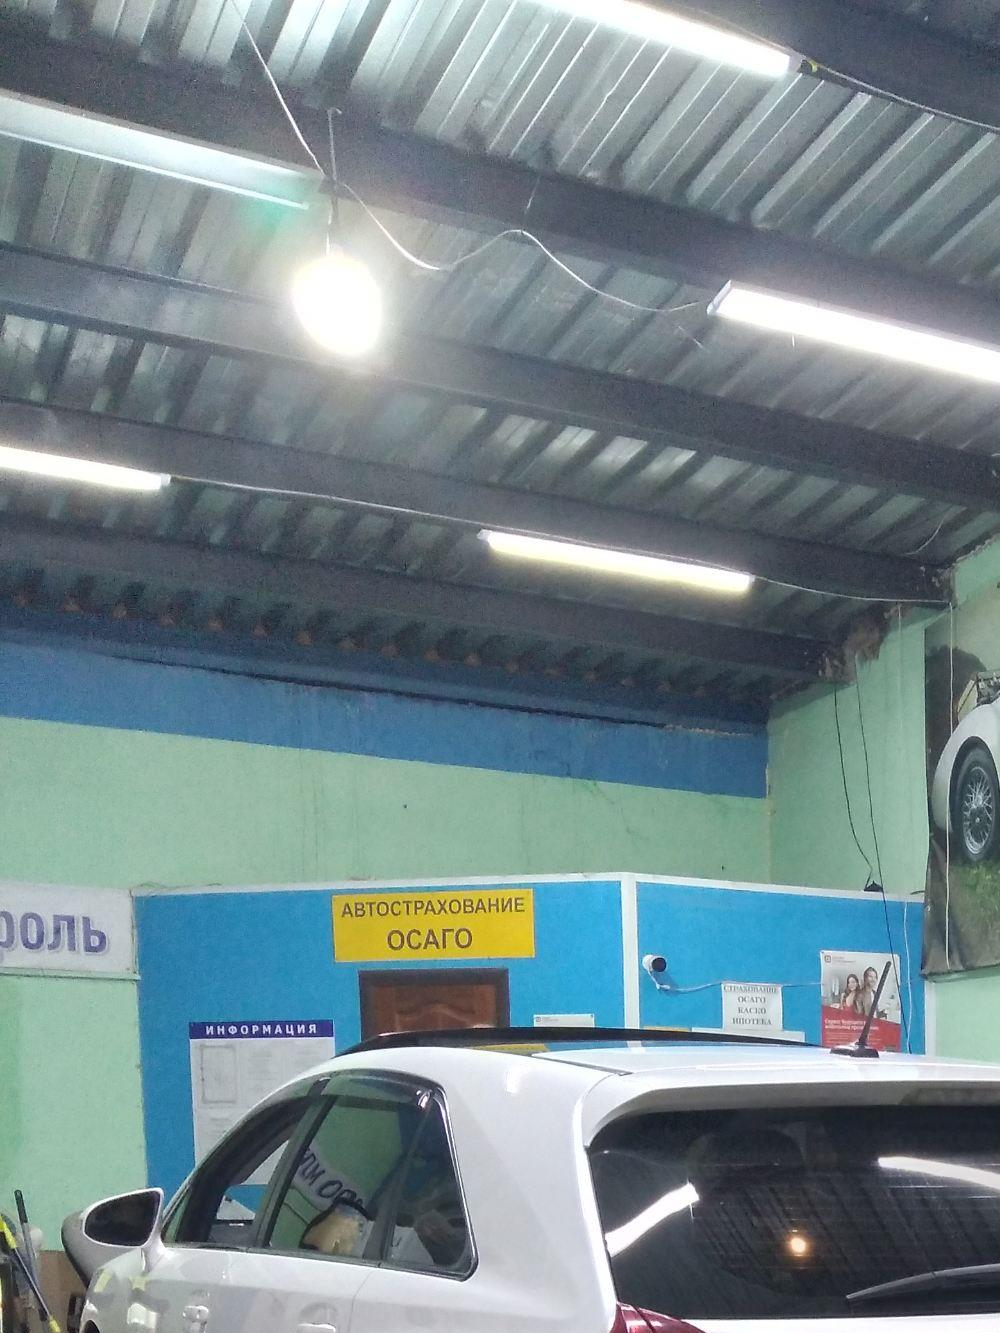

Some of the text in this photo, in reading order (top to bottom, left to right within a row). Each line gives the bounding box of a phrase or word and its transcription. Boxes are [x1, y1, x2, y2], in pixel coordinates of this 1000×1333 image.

[341, 897, 525, 918] АВТОСТРАХОВАНИЕ
[387, 928, 473, 951] ОСАГО
[738, 996, 766, 1004] ОСАГО
[732, 1017, 773, 1025] ИПОТЕКА
[205, 1023, 317, 1036] ИНФОРМАЦИЯ
